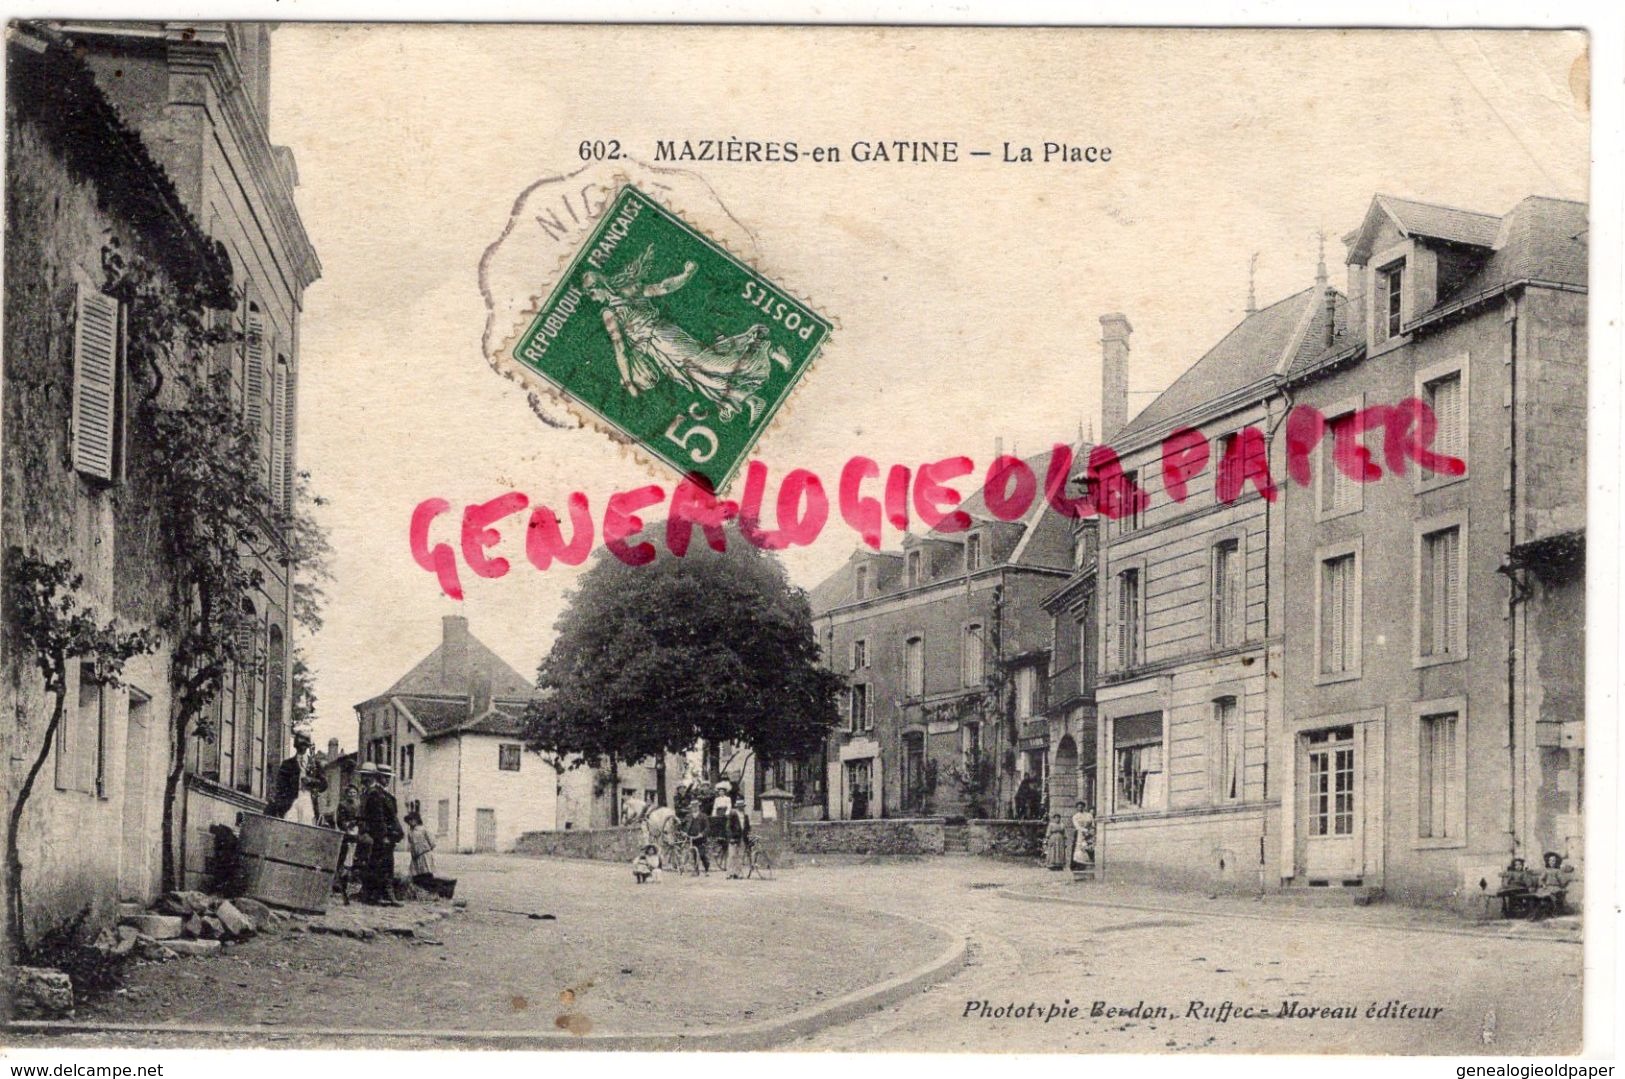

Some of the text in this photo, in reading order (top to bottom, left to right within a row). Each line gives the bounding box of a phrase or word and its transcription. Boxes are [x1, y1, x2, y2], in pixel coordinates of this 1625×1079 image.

[578, 139, 628, 161] 602.
[851, 141, 959, 163] GATINE
[1002, 142, 1033, 163] La
[1043, 142, 1113, 163] Place
[741, 281, 816, 341] POSTES
[1276, 1000, 1358, 1020] Moreau
[1365, 999, 1444, 1020] éditeur
